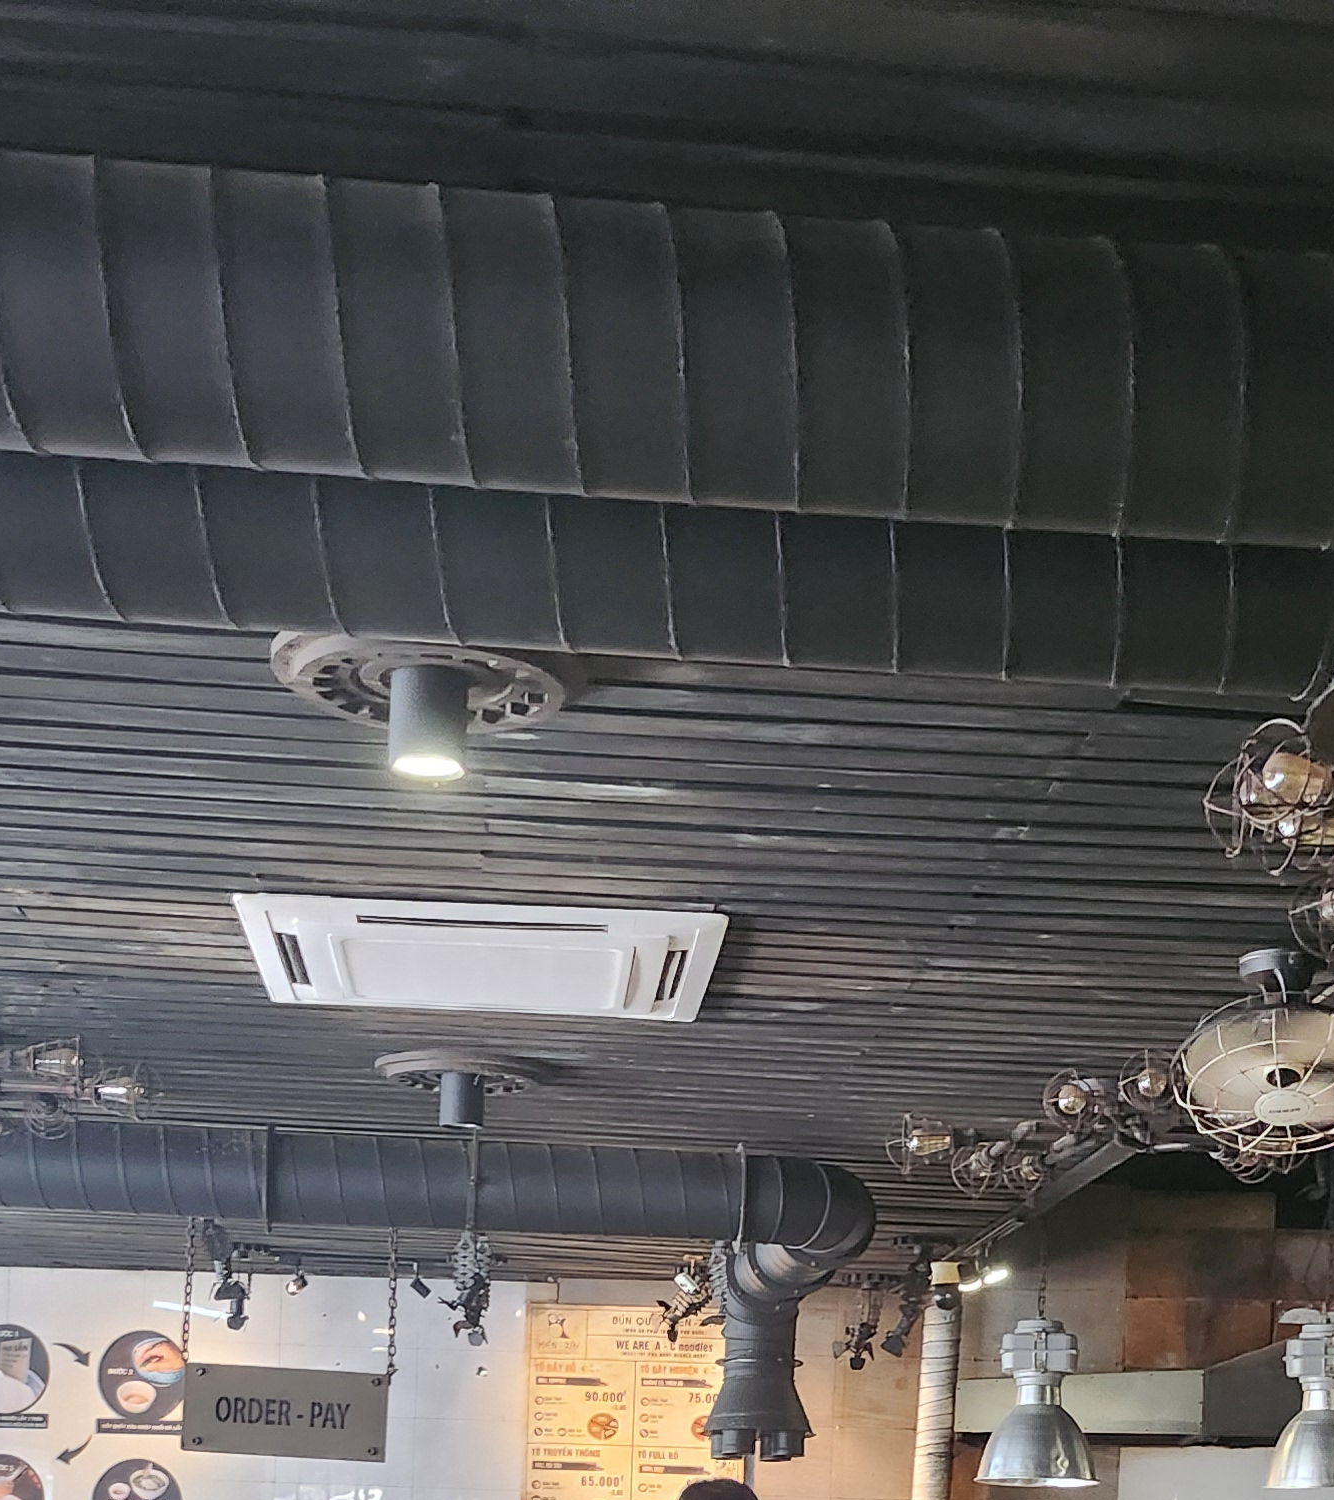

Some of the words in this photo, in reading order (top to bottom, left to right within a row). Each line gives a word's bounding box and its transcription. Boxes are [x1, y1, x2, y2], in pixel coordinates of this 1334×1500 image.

[616, 1340, 629, 1350] WE
[633, 1341, 649, 1350] ARE
[655, 1341, 661, 1350] A
[678, 1342, 713, 1352] noodles
[216, 1396, 291, 1427] ORDER
[309, 1401, 351, 1430] PAY
[648, 1451, 665, 1459] FULL
